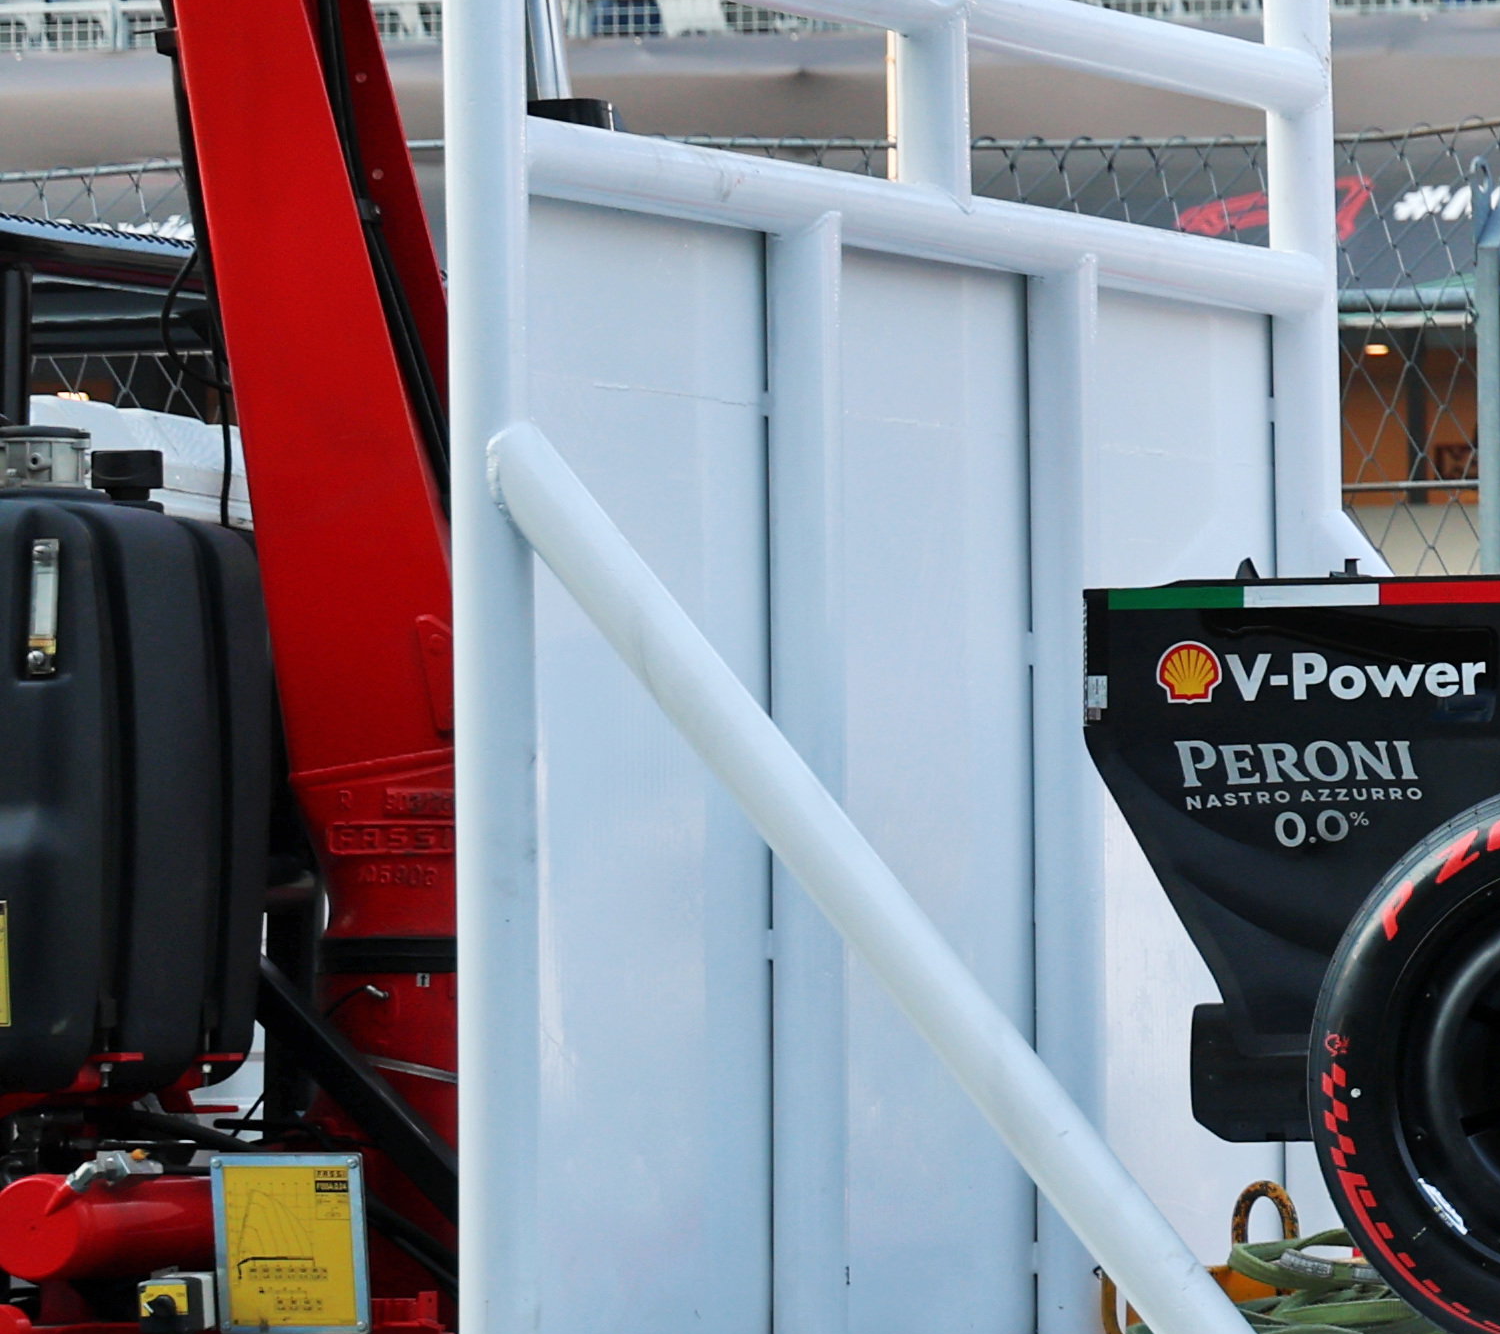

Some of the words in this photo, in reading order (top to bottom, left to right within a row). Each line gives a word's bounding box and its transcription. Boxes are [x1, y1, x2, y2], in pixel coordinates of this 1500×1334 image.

[1225, 651, 1487, 702] V-Power
[1173, 739, 1420, 789] PERONI
[1186, 789, 1291, 811] NASTRO
[1300, 786, 1424, 803] AZZURRO
